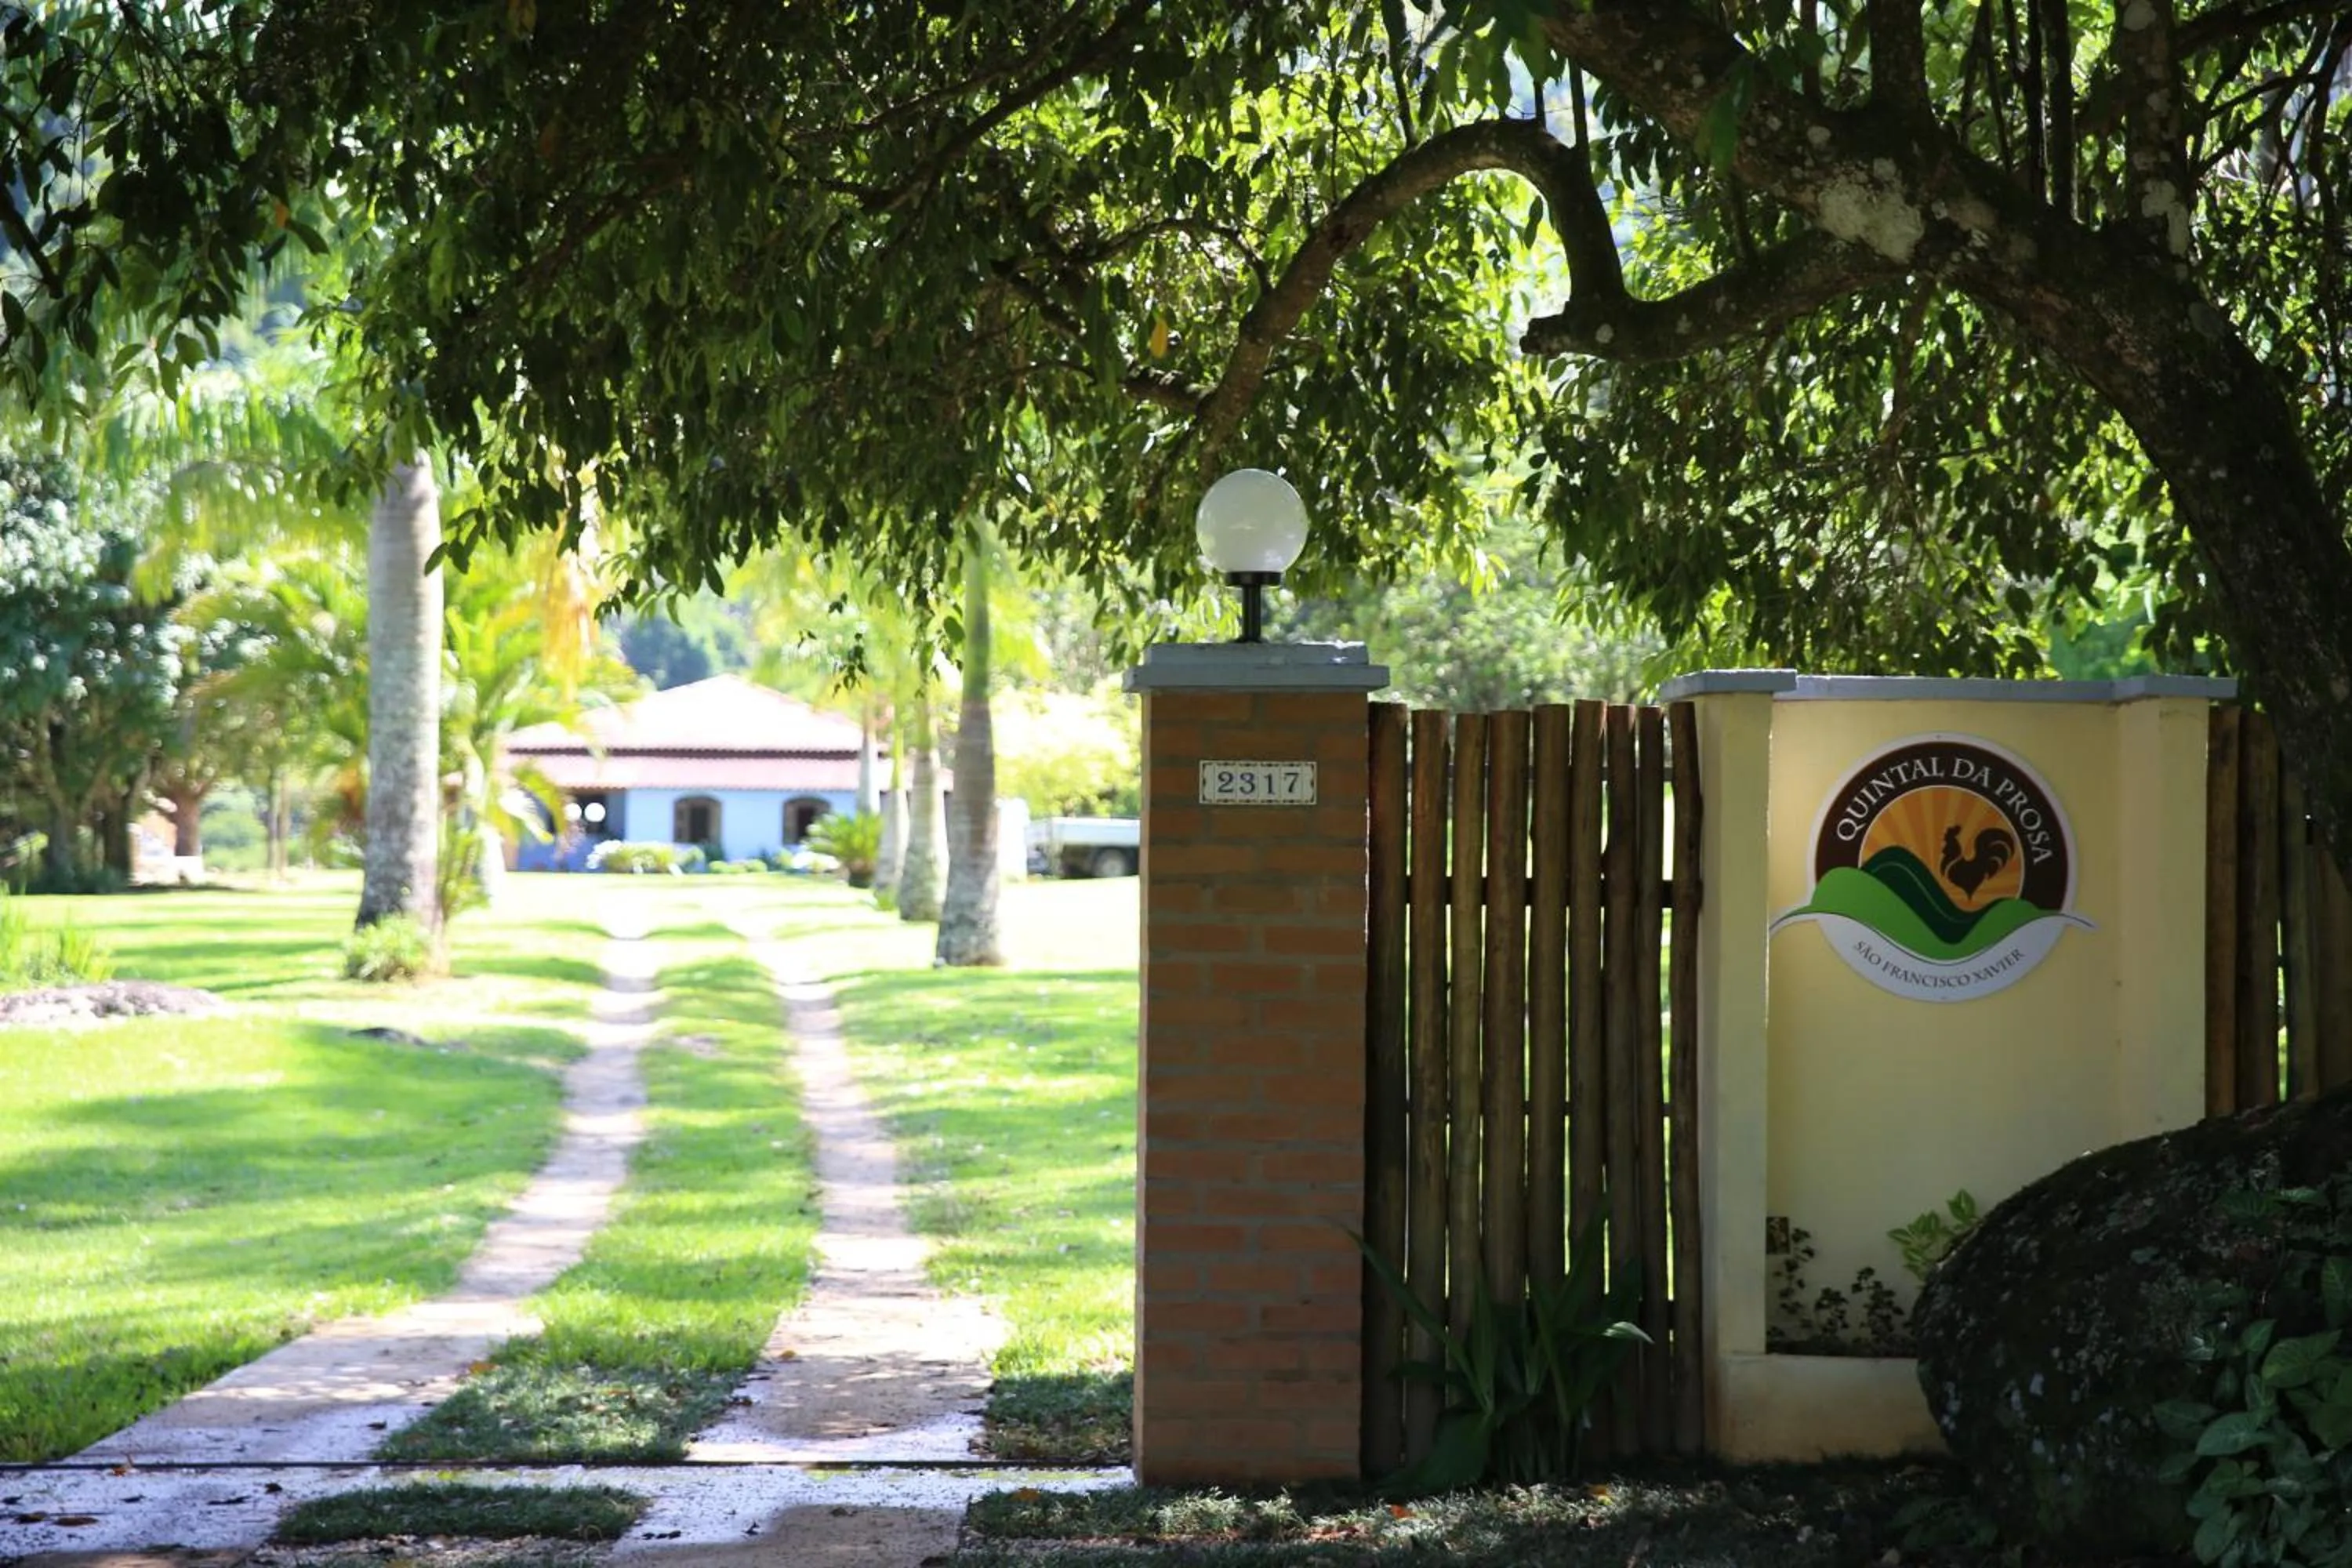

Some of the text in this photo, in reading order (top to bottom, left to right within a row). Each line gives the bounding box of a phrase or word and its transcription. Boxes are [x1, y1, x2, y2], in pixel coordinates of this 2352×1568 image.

[1218, 771, 1300, 794] 2317
[1837, 757, 2052, 864] QUINTAL DA PROSA
[1855, 941, 2026, 989] SÃO FRANCISCO XAVIER
